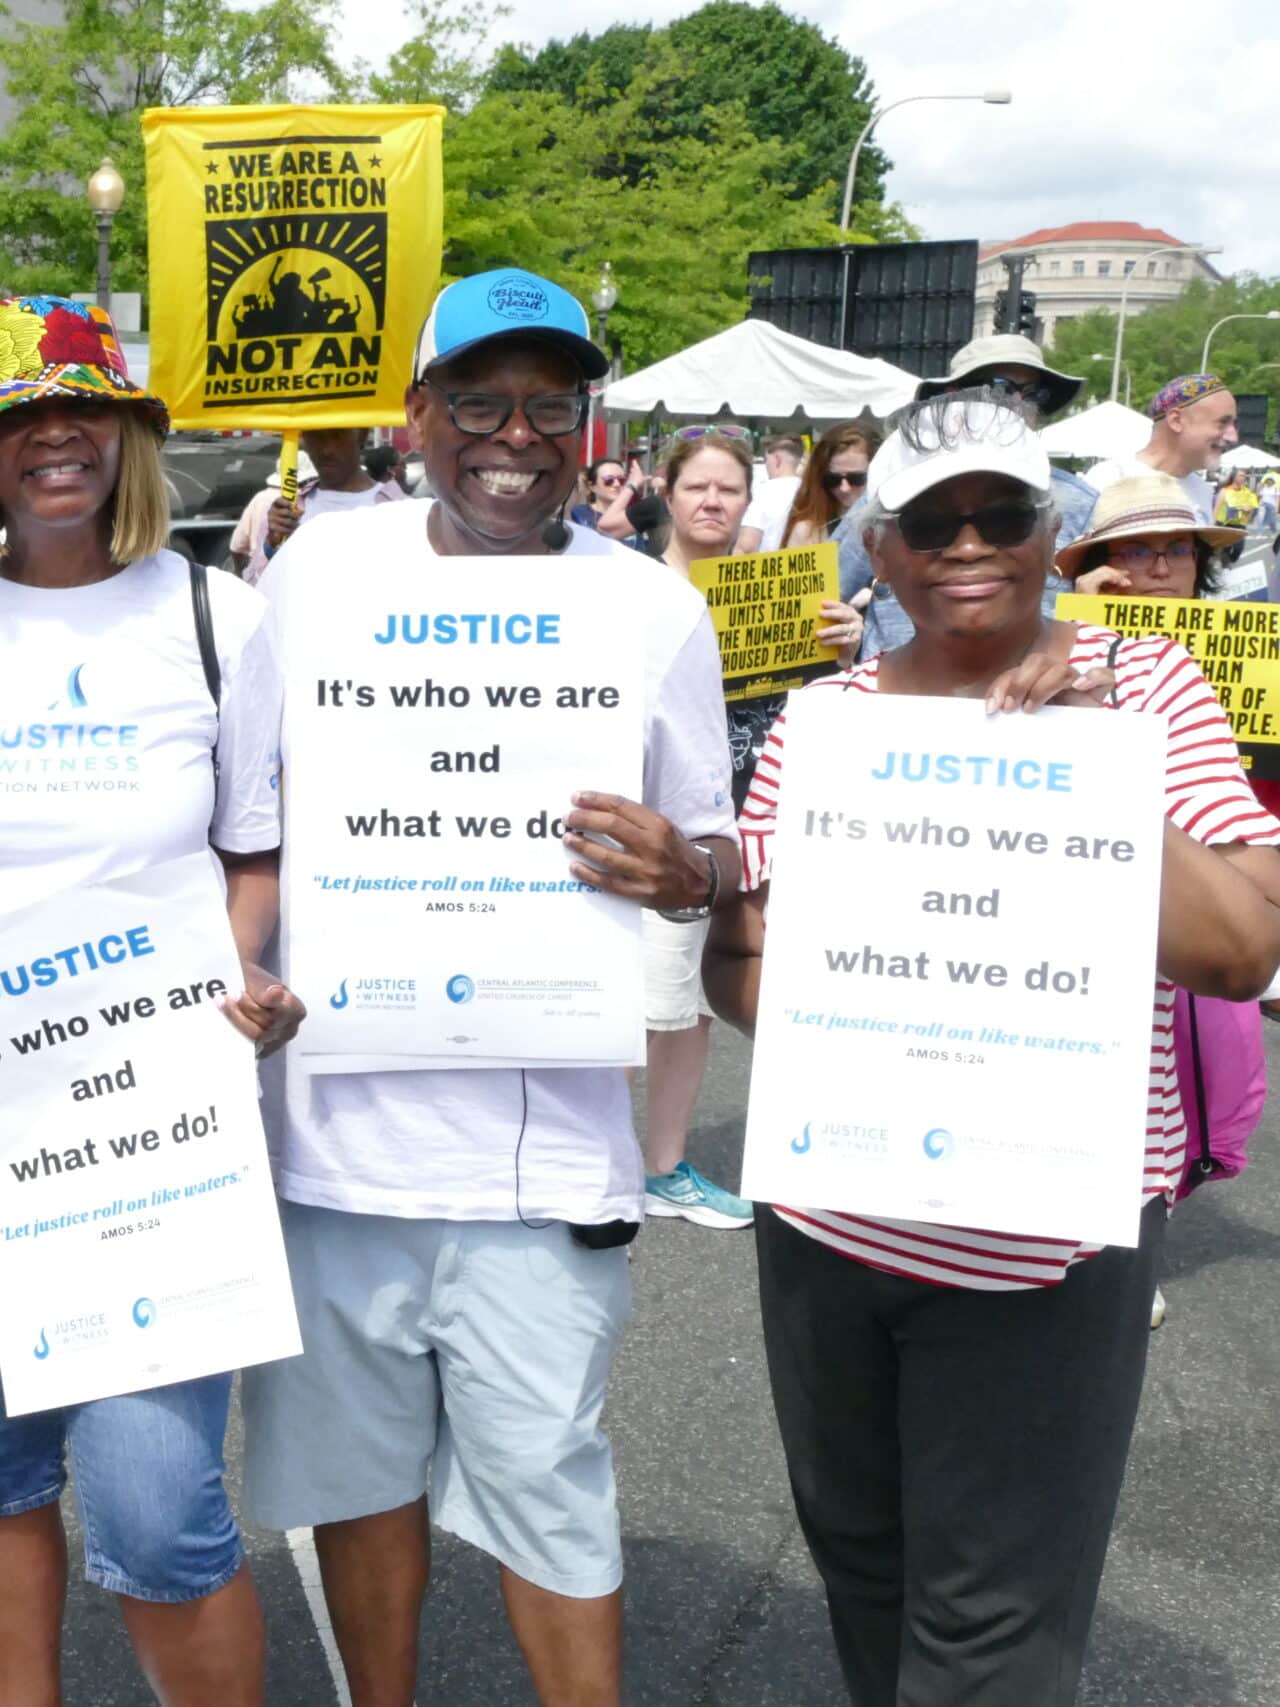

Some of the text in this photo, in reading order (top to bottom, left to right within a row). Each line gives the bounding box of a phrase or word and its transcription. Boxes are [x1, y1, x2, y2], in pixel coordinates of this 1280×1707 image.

[228, 151, 359, 178] WE ARE A
[204, 177, 387, 214] RESURRECTION
[206, 336, 382, 376] NOT AN
[204, 370, 378, 395] INSURRECTION
[718, 552, 816, 584] THERE ARE MORE
[707, 572, 825, 608] AVAILABLE HOUSING
[729, 598, 801, 627] UNITS THAN
[1104, 603, 1279, 634] THERE ARE MORE
[374, 614, 561, 645] JUSTICE
[718, 619, 815, 651] THE NUMBER OF
[720, 640, 818, 672] HOUSED PEOPLE.
[1206, 634, 1280, 659] HOUSIN
[1194, 659, 1244, 683] HAN
[316, 678, 620, 709] It's who we are
[1242, 687, 1266, 710] OF
[1226, 711, 1277, 736] PLE.
[430, 744, 501, 773] and
[871, 751, 1073, 792] JUSTICE
[46, 780, 141, 792] NETWORK
[344, 808, 584, 840] what we do
[803, 809, 1136, 863] It's who we are
[352, 875, 418, 895] justice
[421, 876, 457, 892] roll
[461, 877, 485, 892] on
[489, 876, 525, 892] like
[425, 902, 497, 913] AMOS 5:24
[920, 888, 1000, 918] and
[355, 979, 417, 991] JUSTICE
[824, 945, 1091, 996] what we do!
[362, 993, 417, 1002] WITNESS
[10, 1010, 90, 1056] who
[98, 996, 157, 1029] we
[167, 979, 227, 1010] are
[825, 1010, 898, 1035] justice
[902, 1019, 944, 1039] roll
[947, 1027, 974, 1042] on
[978, 1027, 1019, 1046] like
[905, 1047, 985, 1065] AMOS 5:24
[69, 1059, 137, 1102] and
[9, 1105, 220, 1183] what we do!
[821, 1123, 888, 1141] JUSTICE
[32, 1209, 89, 1238] justice
[92, 1200, 123, 1222] roll
[126, 1198, 148, 1213] on
[150, 1187, 181, 1207] like
[100, 1217, 162, 1241] AMOS 5:24
[55, 1313, 105, 1335] JUSTICE
